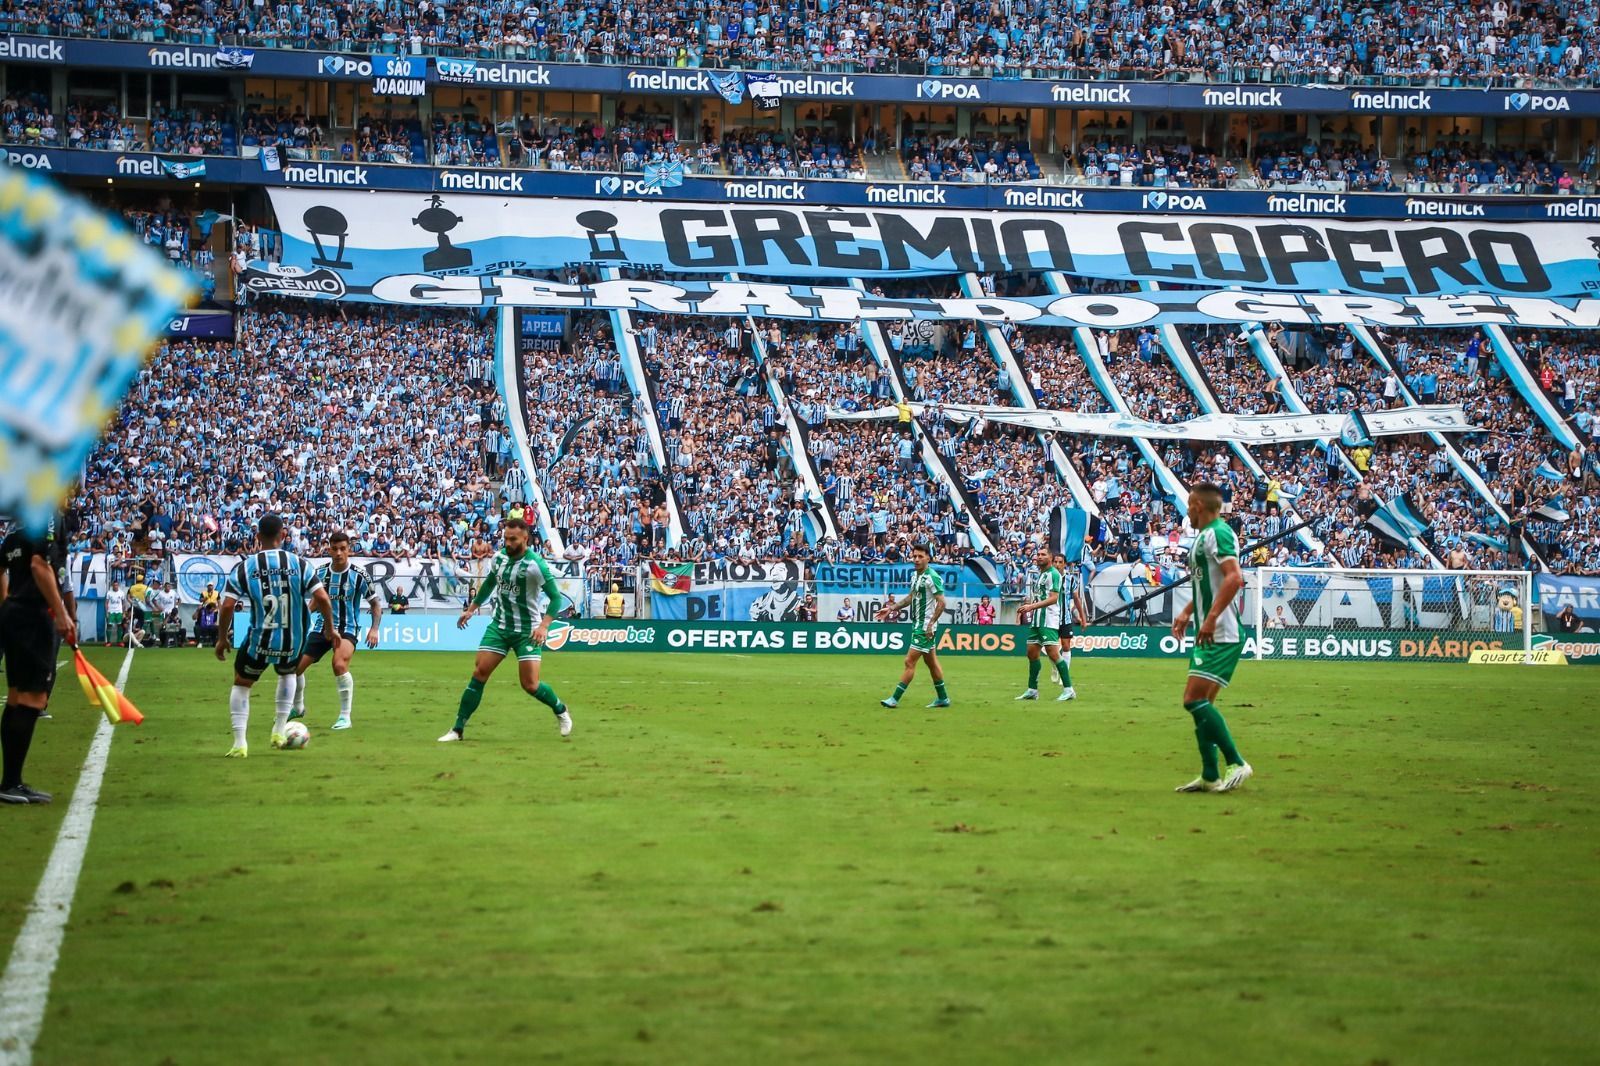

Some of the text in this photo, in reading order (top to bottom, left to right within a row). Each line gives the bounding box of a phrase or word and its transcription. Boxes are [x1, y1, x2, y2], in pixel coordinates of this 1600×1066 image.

[345, 60, 373, 76] PO
[436, 61, 476, 78] CRZ
[372, 77, 426, 96] JOAQUIM
[628, 70, 709, 92] melnick
[778, 74, 854, 96] melnick
[942, 84, 981, 99] POA
[1051, 83, 1131, 103] melnick
[1203, 87, 1282, 106] melnick
[1352, 91, 1431, 110] melnick
[1531, 96, 1570, 111] POA
[8, 153, 53, 171] POA
[284, 164, 367, 186] melnick
[440, 170, 523, 192] melnick
[724, 180, 805, 200] melnick
[865, 185, 946, 204] melnick
[1004, 187, 1084, 208] melnick
[1168, 195, 1207, 210] POA
[1267, 194, 1346, 214] melnick
[1405, 198, 1486, 217] melnick
[659, 205, 1553, 295] GRÊMIO COPERO
[248, 276, 339, 291] GRÊMIO
[262, 594, 289, 630] 21
[686, 595, 721, 620] DE
[570, 626, 1016, 652] segurobet OFERTAS E BÔNUS ÁRIOS
[1282, 637, 1298, 656] E
[1304, 634, 1394, 658] BÔNUS
[255, 646, 295, 657] Unimed
[1480, 651, 1550, 665] quartzlit
